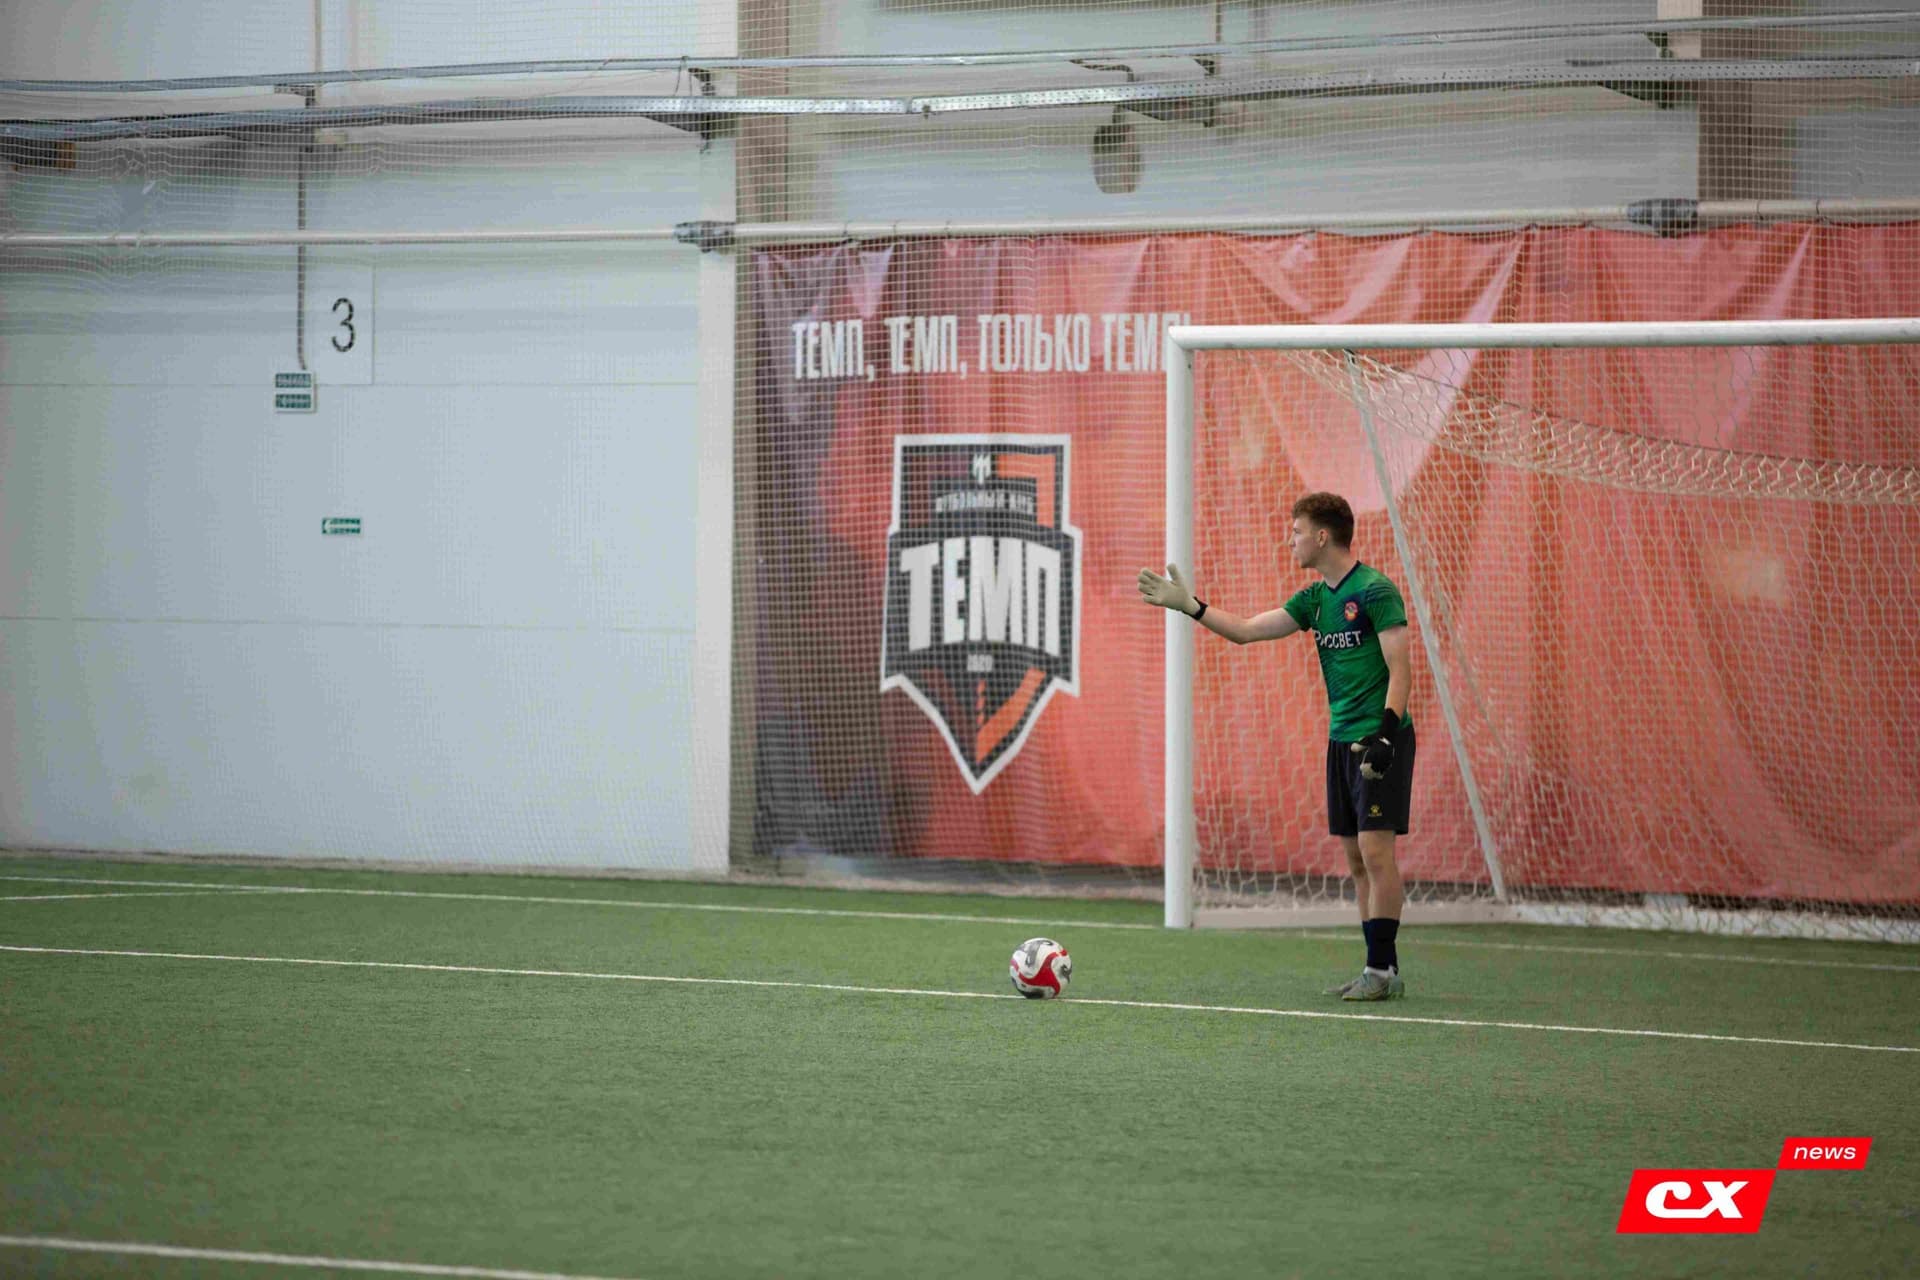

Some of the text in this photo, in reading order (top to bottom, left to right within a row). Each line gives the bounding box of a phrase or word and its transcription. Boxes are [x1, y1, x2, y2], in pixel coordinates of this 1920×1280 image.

[331, 297, 355, 352] 3
[792, 312, 1191, 382] ТЕМП, ТЕМП, ТОЛЬКО ТЕМП
[900, 535, 1061, 657] ТЕМП
